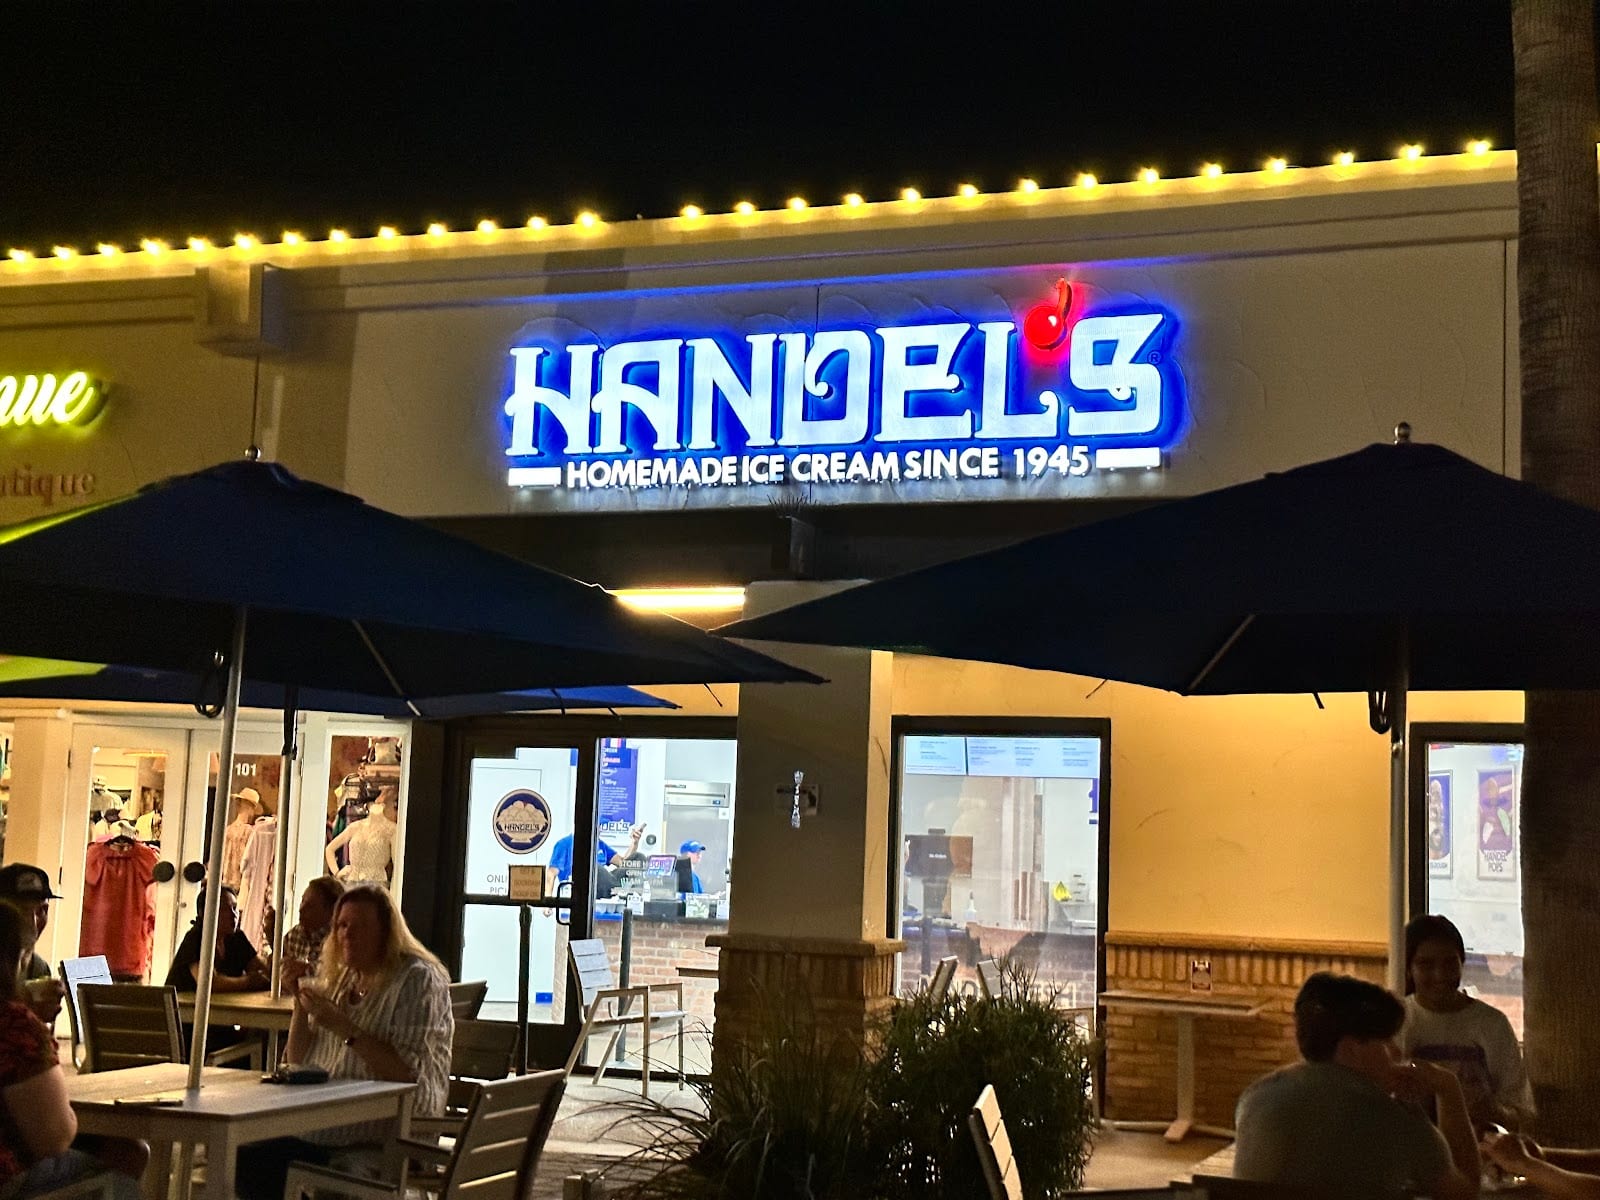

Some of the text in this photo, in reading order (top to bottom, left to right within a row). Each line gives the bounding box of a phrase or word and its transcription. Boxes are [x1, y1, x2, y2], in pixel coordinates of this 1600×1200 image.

[504, 303, 1163, 455] HANDEL'S
[567, 445, 1089, 488] HOMEMADE ICE CREAM SINCE 1945
[235, 763, 257, 776] 101
